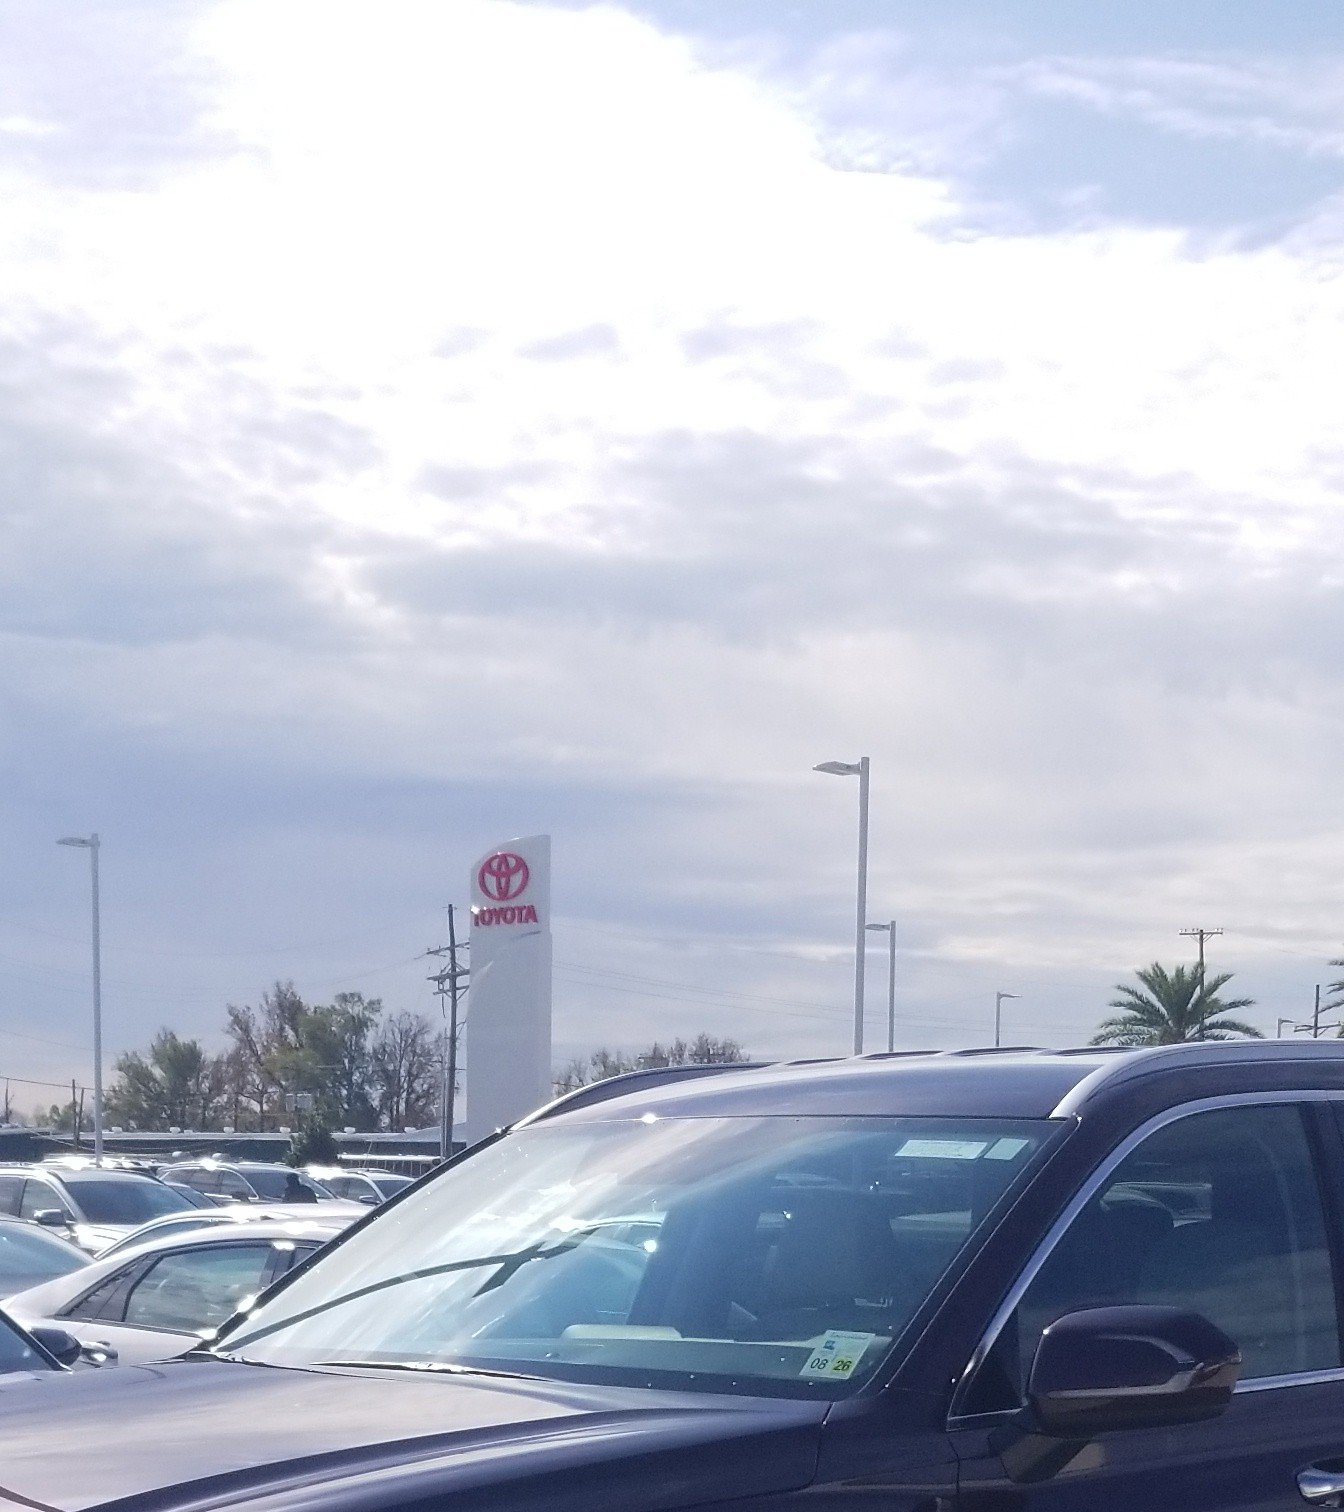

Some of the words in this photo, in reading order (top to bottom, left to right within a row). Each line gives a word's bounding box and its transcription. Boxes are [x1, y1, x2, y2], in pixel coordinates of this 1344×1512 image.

[470, 904, 538, 927] TOYOTA
[810, 1358, 828, 1369] 08
[833, 1360, 852, 1371] 26
